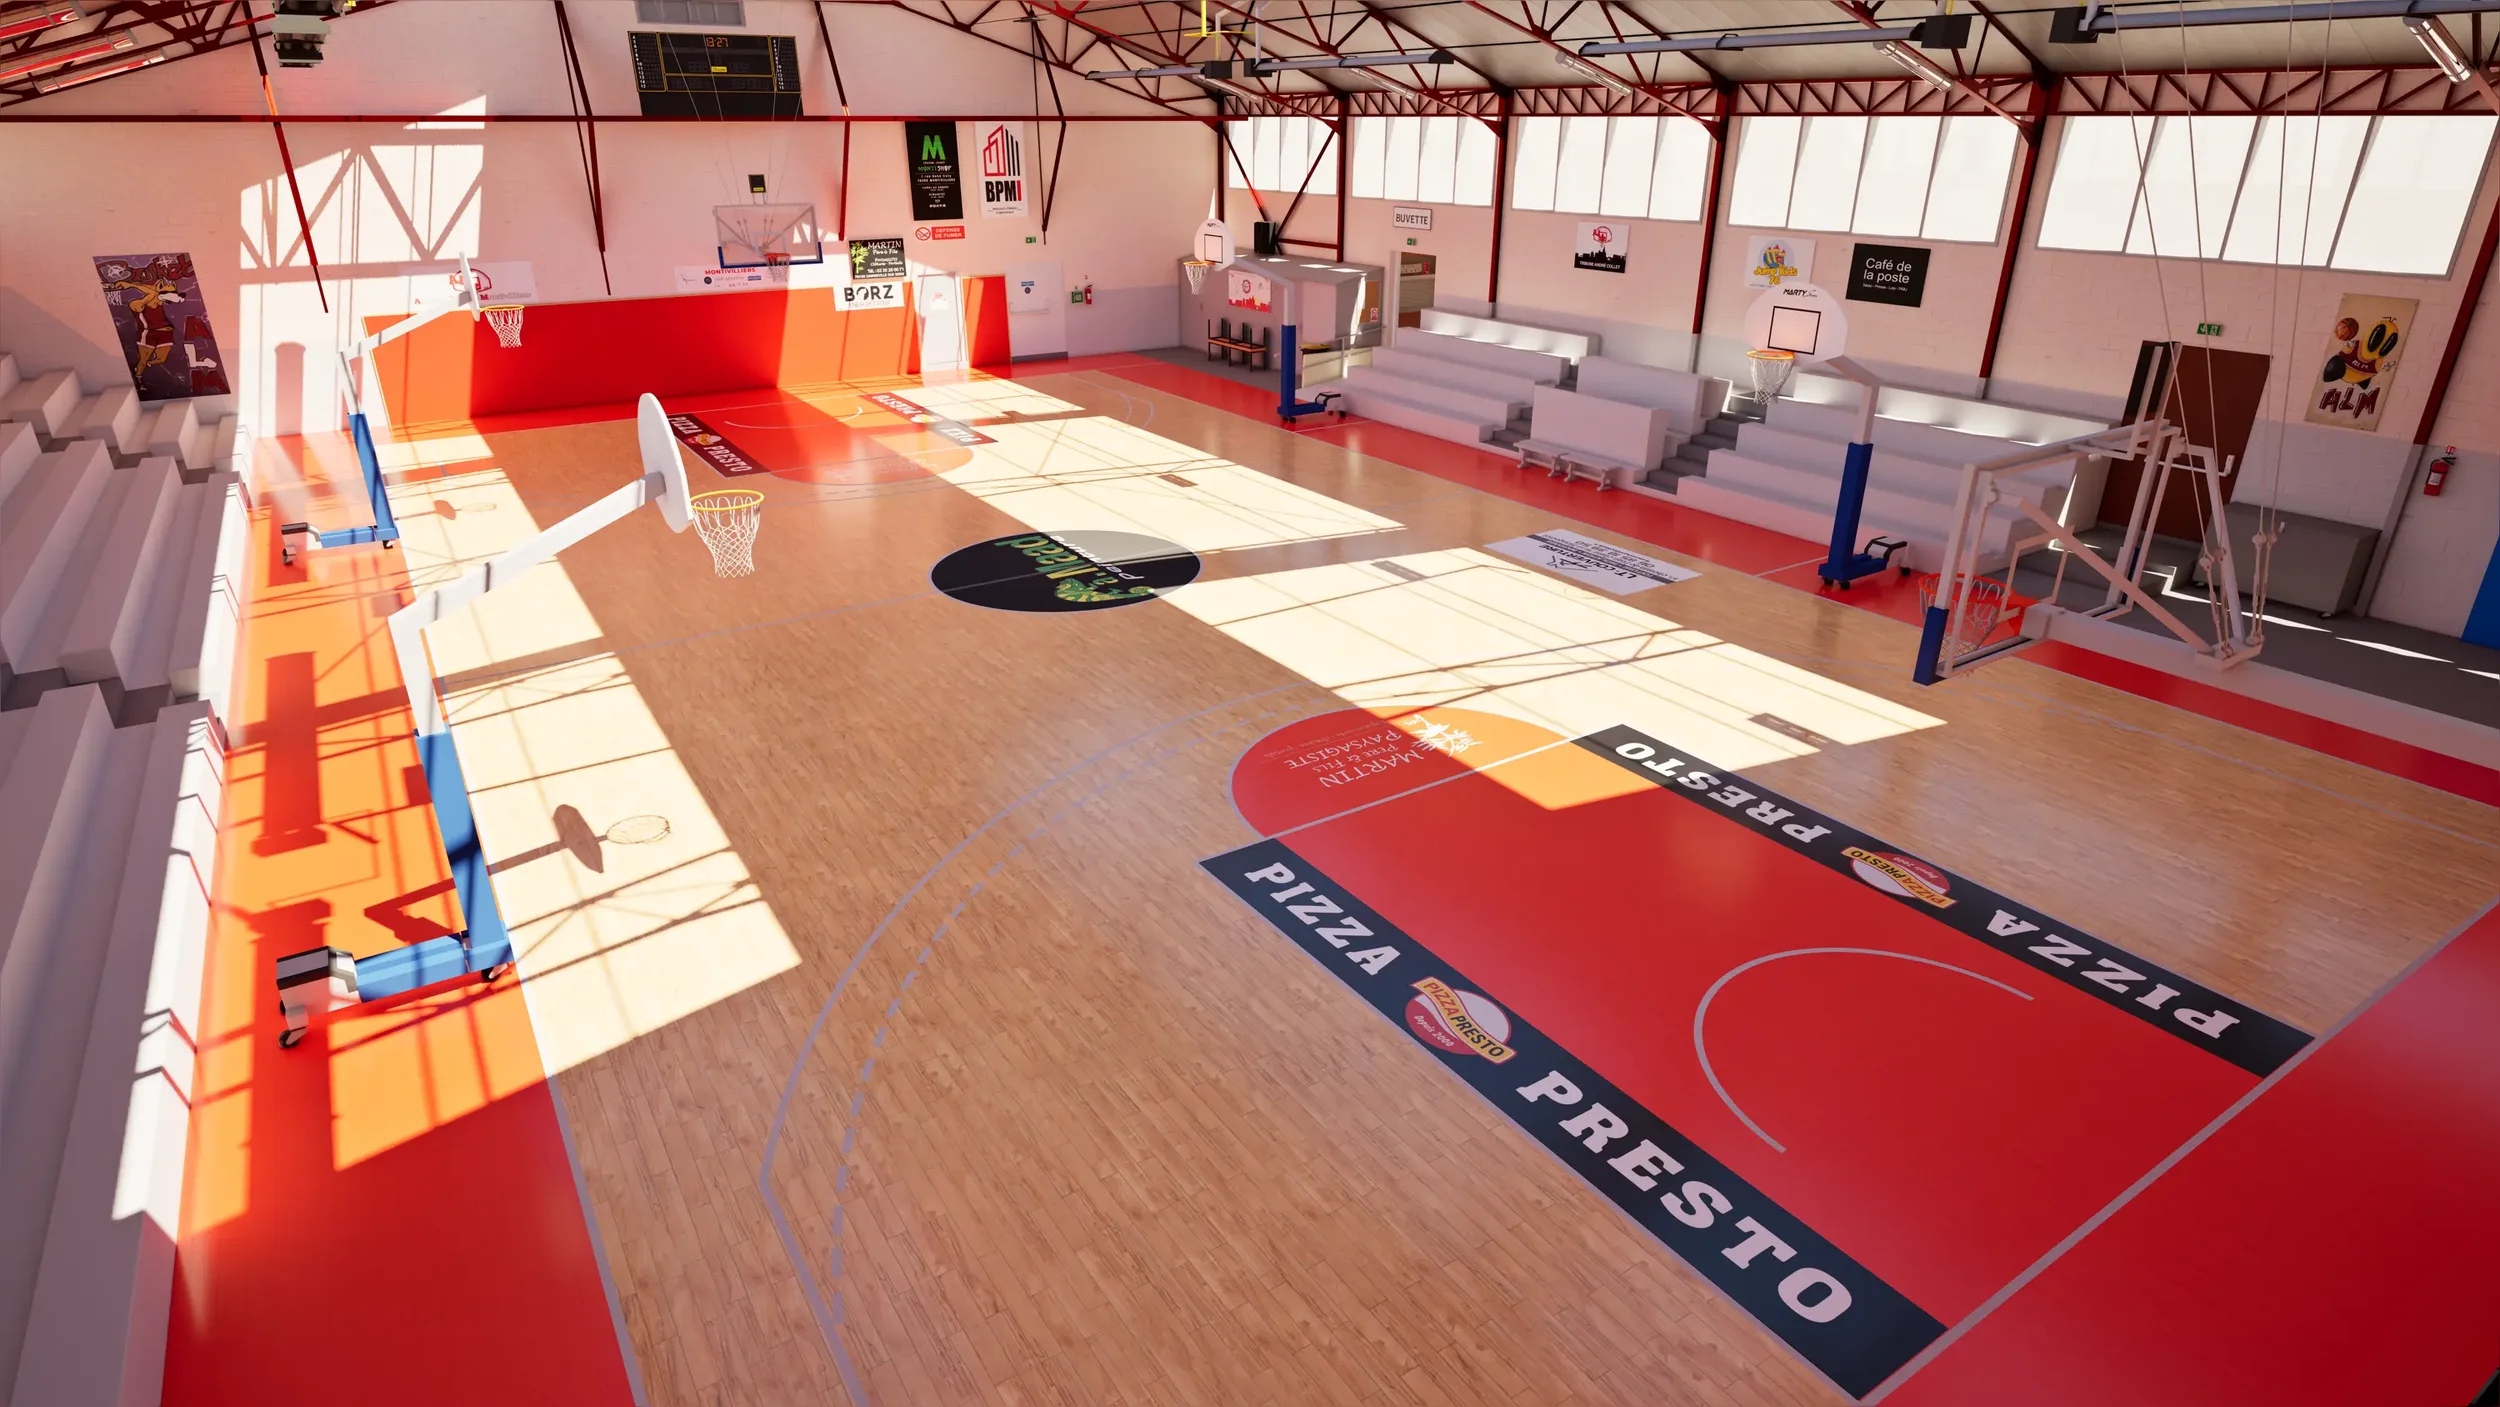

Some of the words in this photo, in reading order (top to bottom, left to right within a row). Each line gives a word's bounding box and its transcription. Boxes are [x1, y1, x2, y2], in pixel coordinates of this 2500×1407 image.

[922, 134, 946, 160] M
[985, 180, 1022, 202] BPMI
[1396, 214, 1428, 225] BUVETTE
[868, 240, 902, 249] MARTIN
[1754, 266, 1777, 276] Jump
[1779, 266, 1798, 276] Kids
[1864, 269, 1874, 280] la
[1877, 273, 1909, 283] poste
[1866, 258, 1893, 270] Café
[1896, 261, 1911, 272] de
[1769, 276, 1780, 285] 76
[2319, 387, 2380, 418] ALM
[668, 416, 702, 434] PIZZA
[703, 446, 752, 472] PRESTO
[1050, 536, 1145, 580] peinture
[1539, 544, 1637, 579] LT-COUVERTURE
[1284, 730, 1402, 769] PAYSAGISTE
[1347, 755, 1361, 763] &
[1362, 744, 1398, 758] PERE
[1312, 759, 1346, 773] FILS
[1319, 750, 1424, 788] MARTIN
[1615, 742, 1832, 844] PRESTO
[1850, 850, 1906, 879] PRESTO
[1901, 878, 1946, 905] PIZZA
[1244, 861, 1401, 976] PIZZA
[1986, 909, 2240, 1039] PIZZA
[1414, 1015, 1435, 1033] Depuis
[1432, 1032, 1454, 1047] 2000
[1424, 982, 1460, 1016] PIZZA
[1450, 1016, 1505, 1057] PRESTO
[1516, 1070, 1854, 1323] PRESTO
